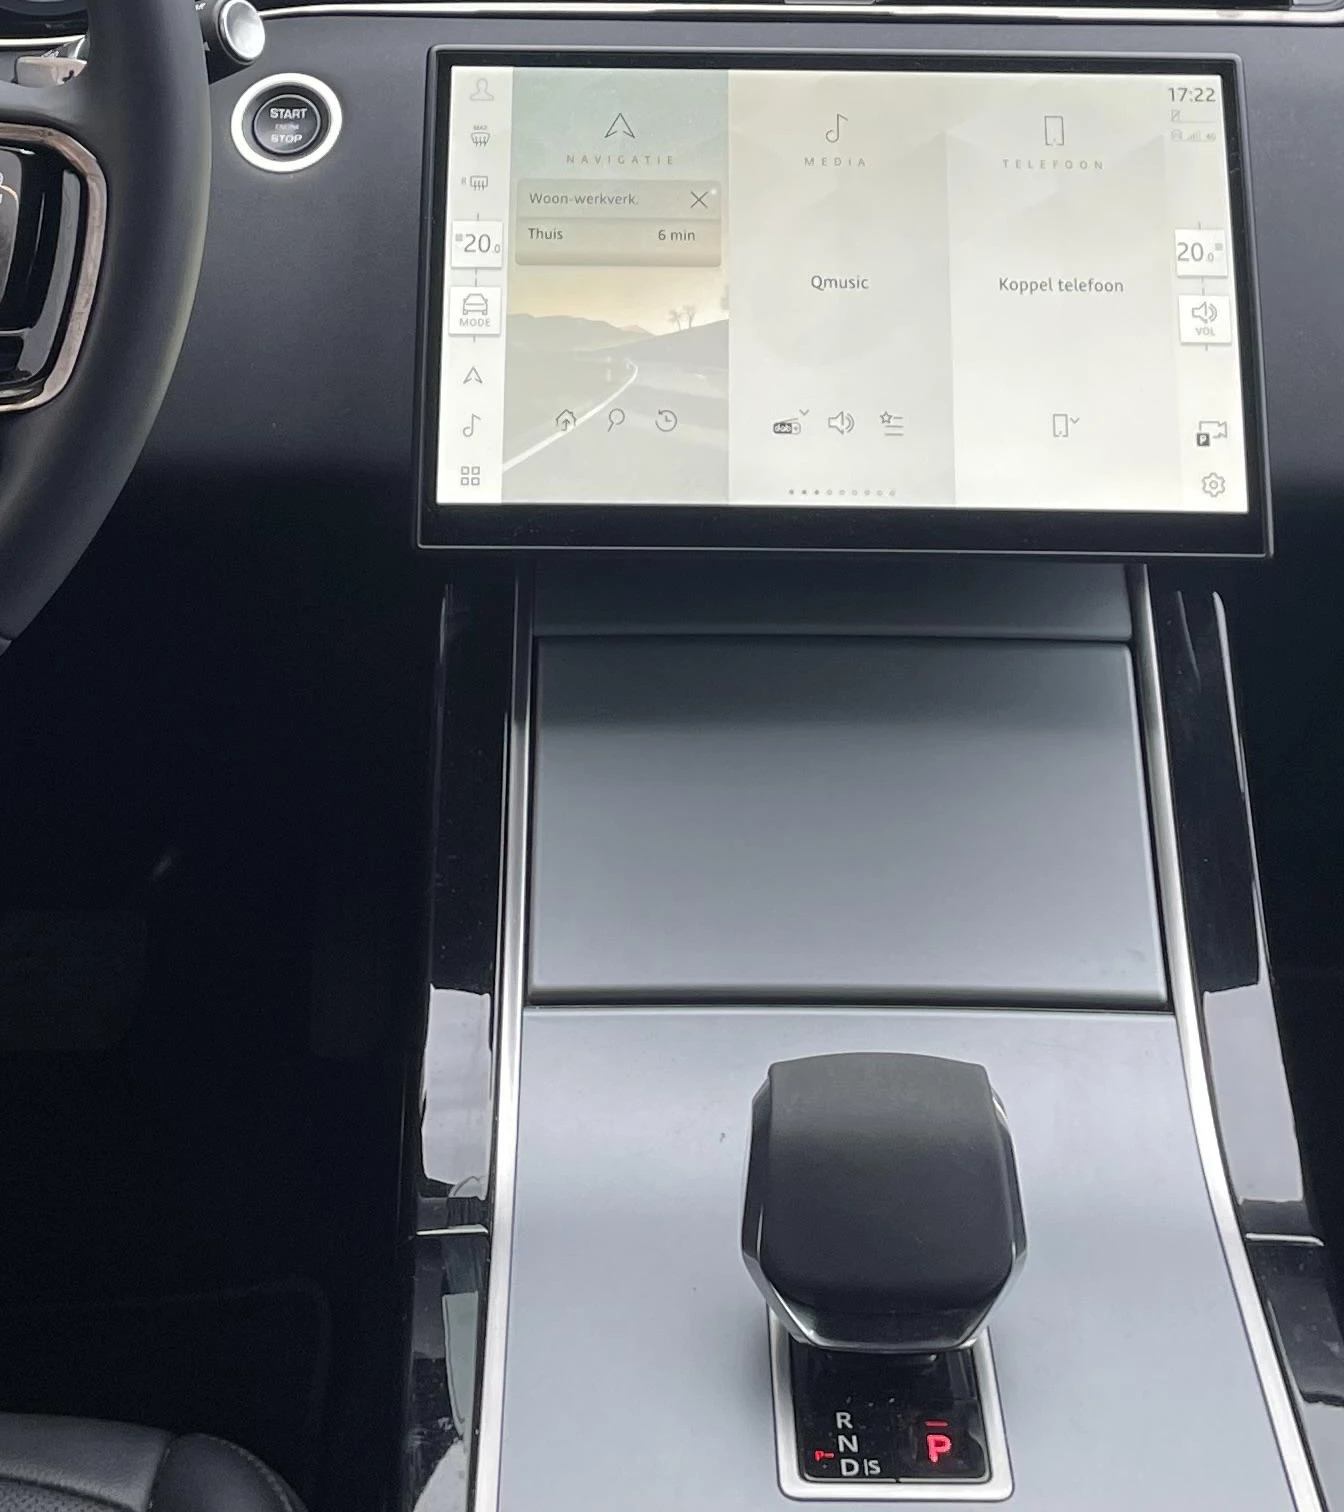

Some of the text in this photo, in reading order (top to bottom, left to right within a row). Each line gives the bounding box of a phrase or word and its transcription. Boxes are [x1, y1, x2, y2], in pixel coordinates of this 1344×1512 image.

[1168, 87, 1216, 103] 17:22
[270, 108, 308, 119] START
[271, 134, 303, 144] STOP
[566, 154, 674, 166] NAVIGATIE
[804, 156, 867, 168] MEDIA
[1002, 159, 1105, 170] TELEFOON
[529, 191, 640, 206] Woon-werkverk.
[528, 227, 696, 241] Thuis 6 min
[810, 275, 869, 291] Qmusic
[998, 277, 1124, 295] Koppel telefoon
[459, 318, 490, 327] MODE
[1195, 327, 1216, 336] VOL
[835, 1411, 853, 1429] R
[838, 1435, 858, 1453] N
[926, 1434, 952, 1463] P
